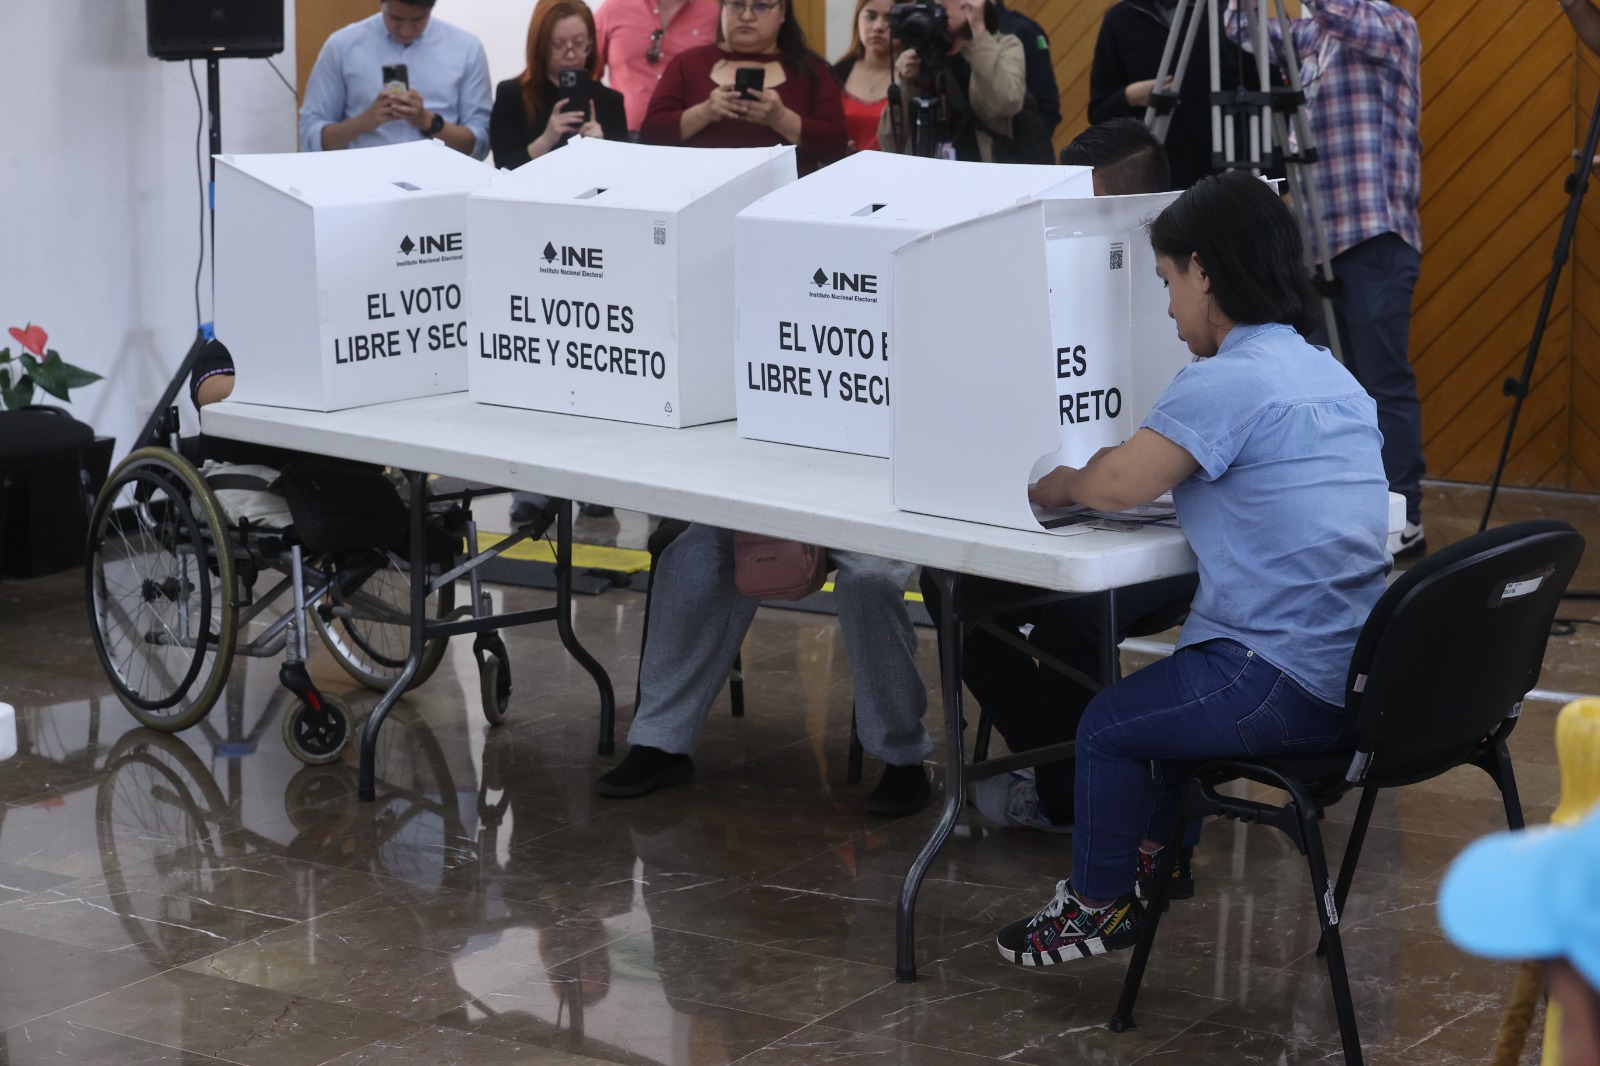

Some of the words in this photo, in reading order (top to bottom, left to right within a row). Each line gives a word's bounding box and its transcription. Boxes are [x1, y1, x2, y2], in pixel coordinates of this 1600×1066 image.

[420, 232, 463, 254] INE
[441, 254, 463, 262] Electoral
[561, 246, 603, 269] INE
[540, 266, 559, 274] Instituto
[560, 268, 581, 276] Nacional
[582, 270, 603, 278] Electoral
[833, 272, 877, 293] INE
[367, 292, 395, 320] EL
[400, 283, 461, 315] VOTO
[510, 295, 536, 323] EL
[541, 297, 600, 330] VOTO
[607, 304, 634, 334] ES
[809, 291, 830, 299] Instituto
[831, 293, 853, 301] Nacional
[854, 295, 878, 303] Electoral
[334, 330, 401, 364] LIBRE
[406, 327, 421, 353] Y
[480, 332, 541, 364] LIBRE
[546, 338, 560, 366] Y
[566, 340, 666, 380] SECRETO
[779, 321, 806, 352] EL
[811, 324, 874, 359] VOTO
[1057, 345, 1087, 379] ES
[748, 361, 812, 397] LIBRE
[817, 368, 832, 398] Y
[839, 371, 890, 406] SEC
[1059, 387, 1122, 426] RETO
